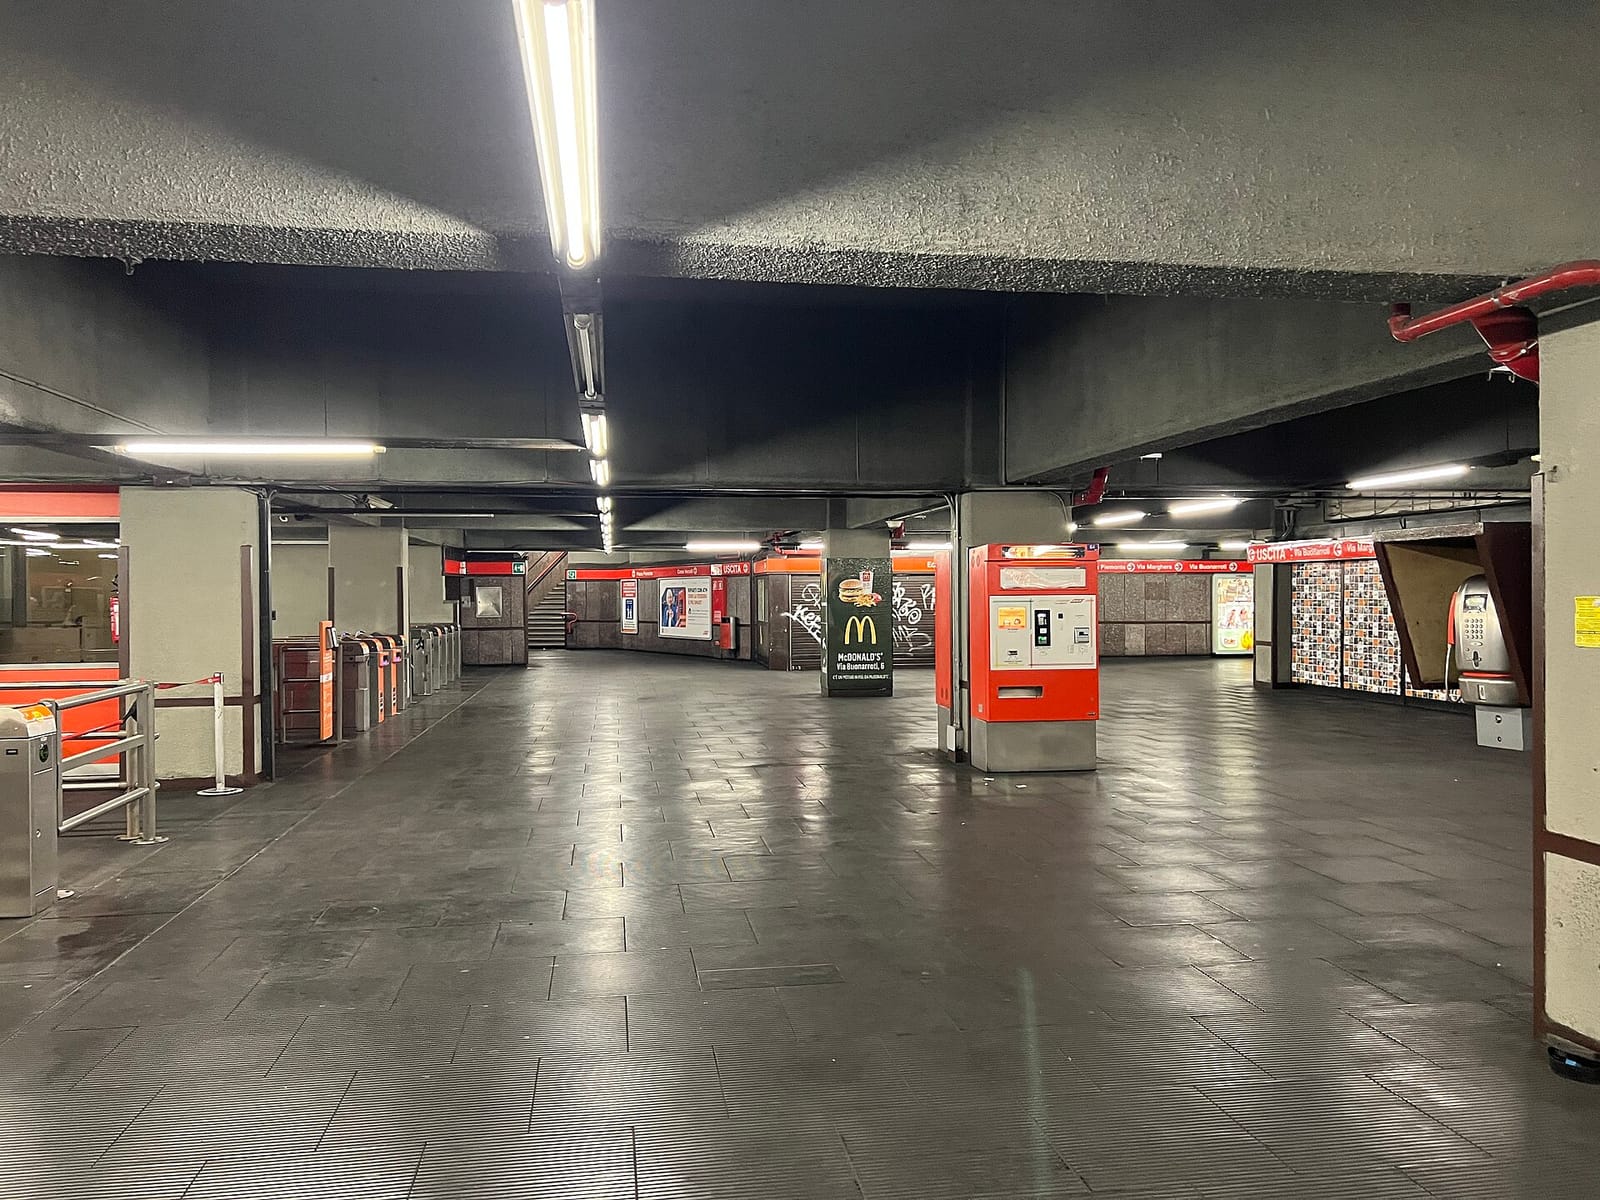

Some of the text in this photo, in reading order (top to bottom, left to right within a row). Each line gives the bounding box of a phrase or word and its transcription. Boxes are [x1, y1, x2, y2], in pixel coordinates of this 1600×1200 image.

[1294, 548, 1302, 557] Via
[1346, 543, 1356, 553] Via
[1256, 548, 1286, 561] USCITA
[723, 564, 742, 574] USCITA
[1147, 564, 1172, 572] Marghera
[836, 662, 846, 671] Via
[880, 662, 885, 670] 6
